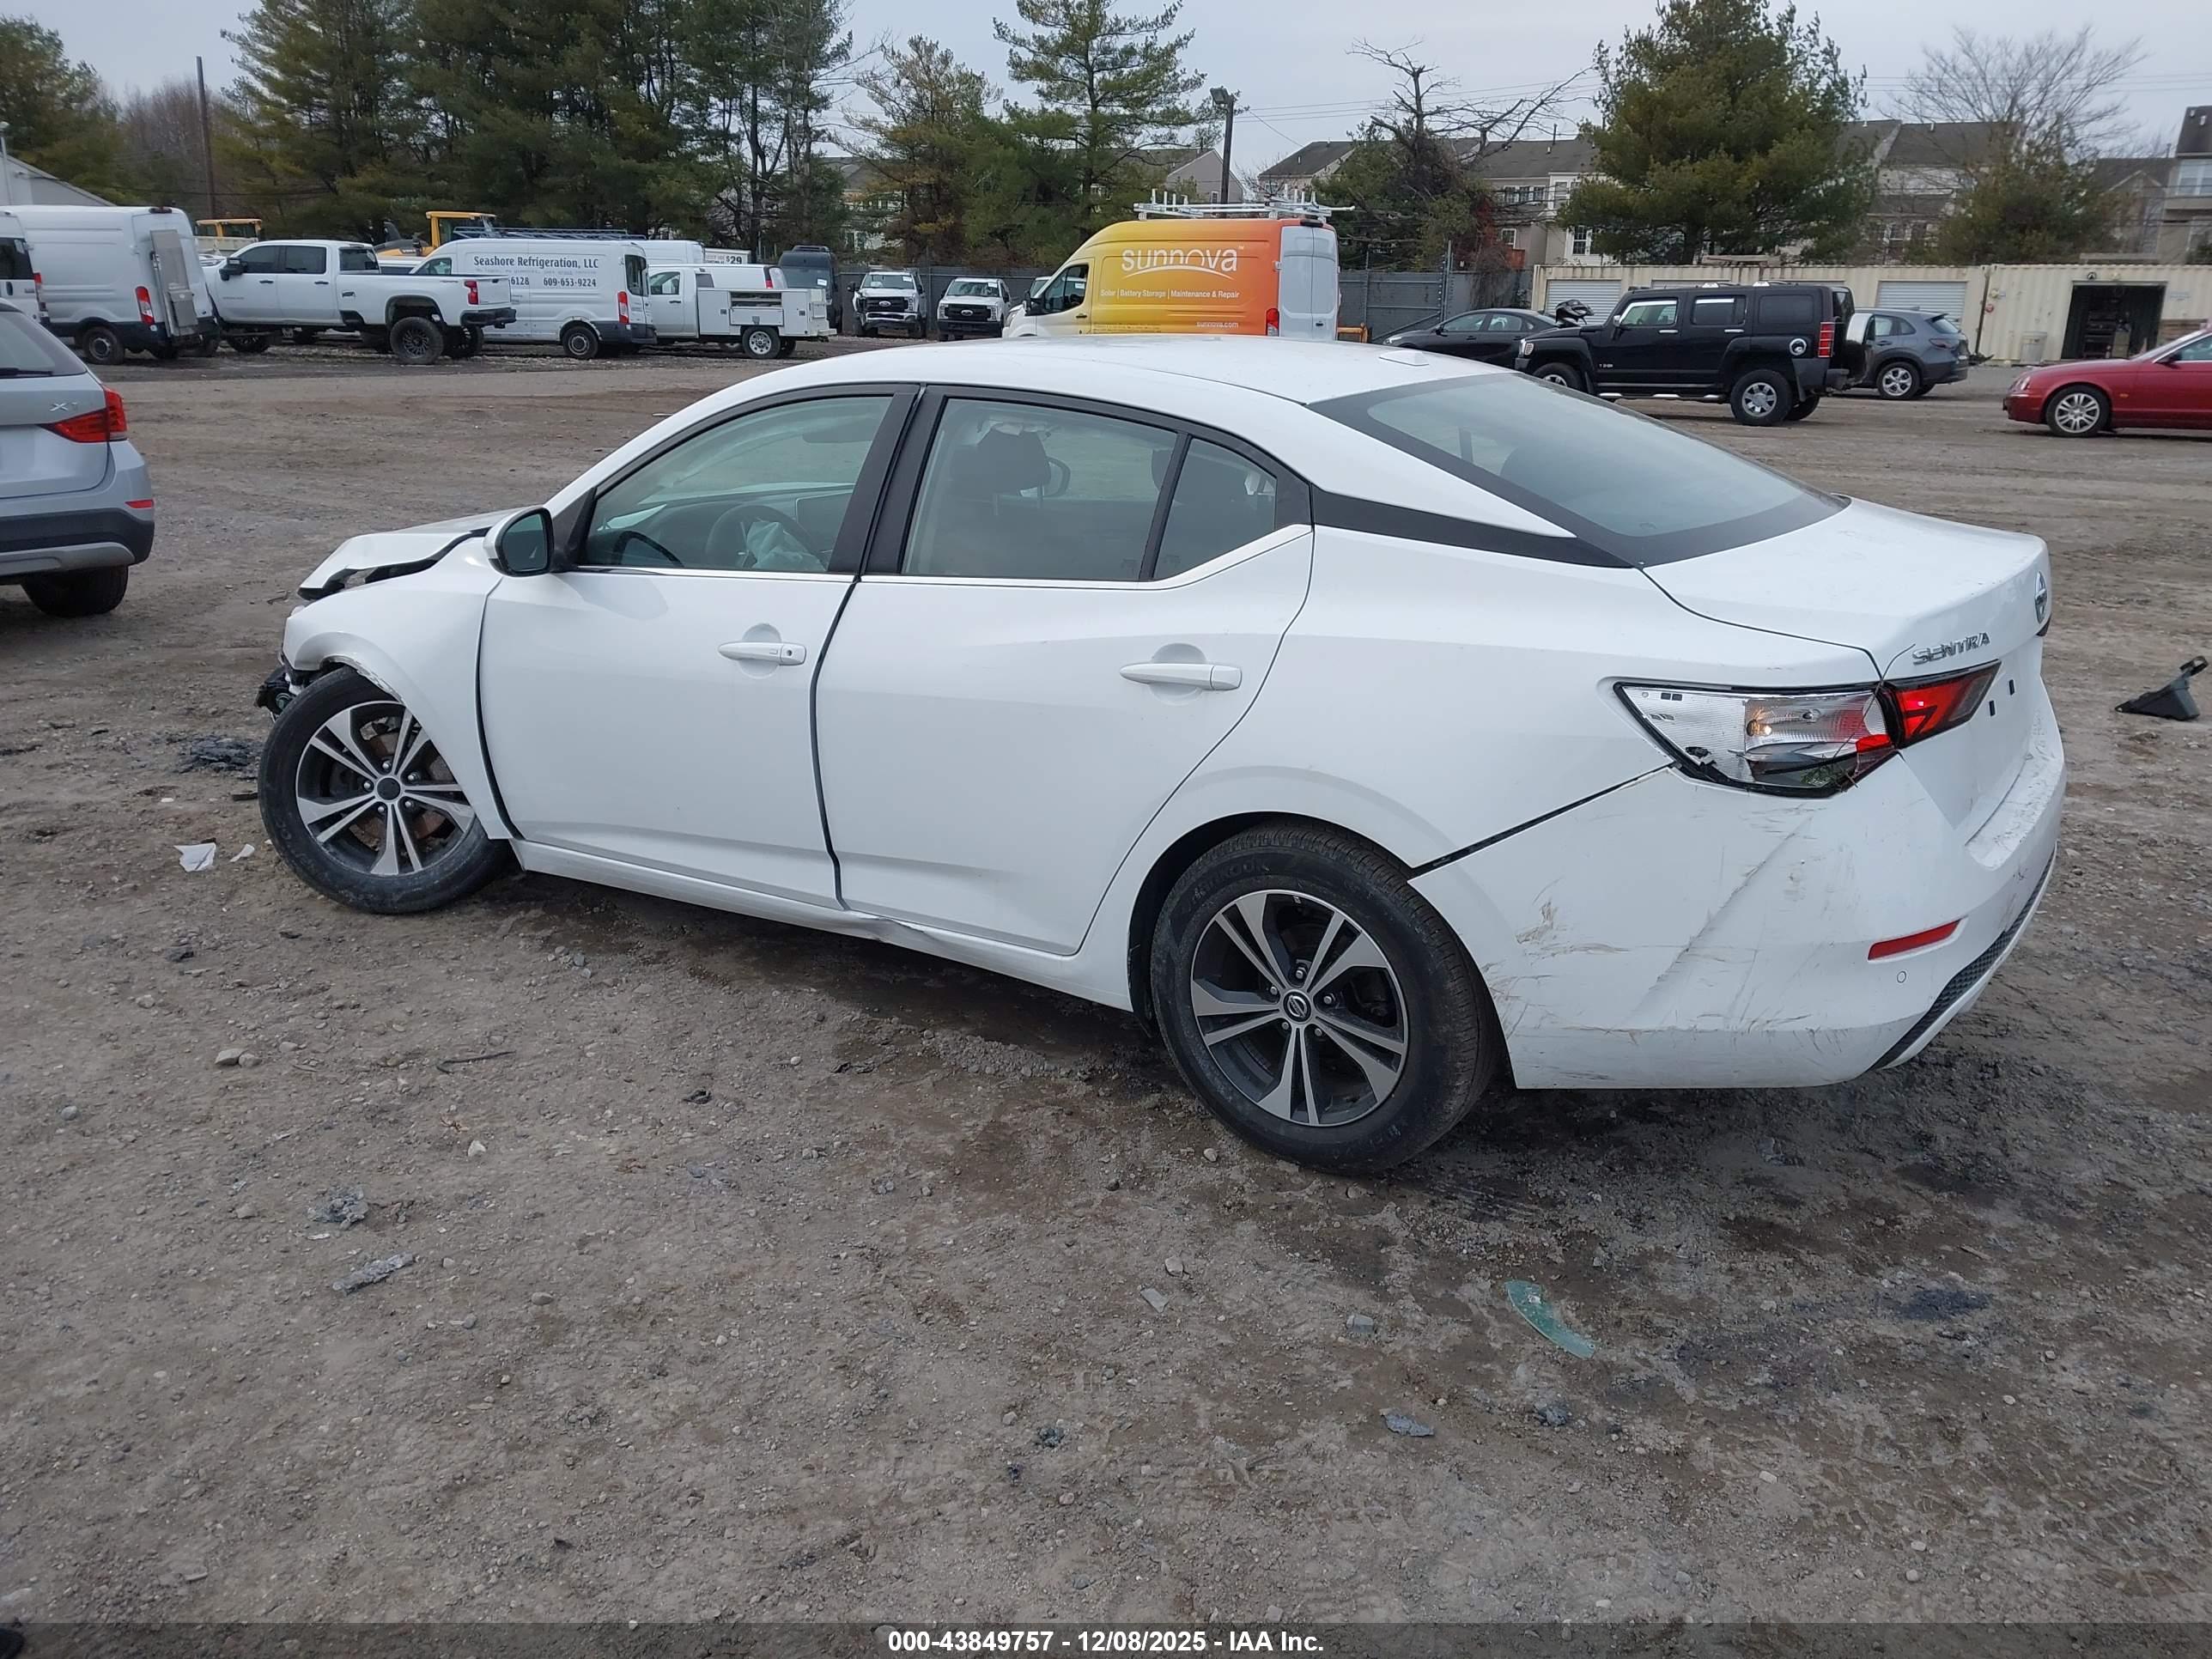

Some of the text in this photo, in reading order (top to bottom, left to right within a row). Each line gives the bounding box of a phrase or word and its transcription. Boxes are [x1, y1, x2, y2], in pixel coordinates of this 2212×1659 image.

[474, 256, 599, 269] Seashore Refrigeration, LLC
[1121, 248, 1237, 271] sunnova
[1100, 289, 1115, 297] Solar
[1120, 289, 1141, 299] Battery
[1170, 289, 1211, 298] Maintenance
[1218, 290, 1240, 300] Repair
[1911, 632, 1990, 665] SENTRA
